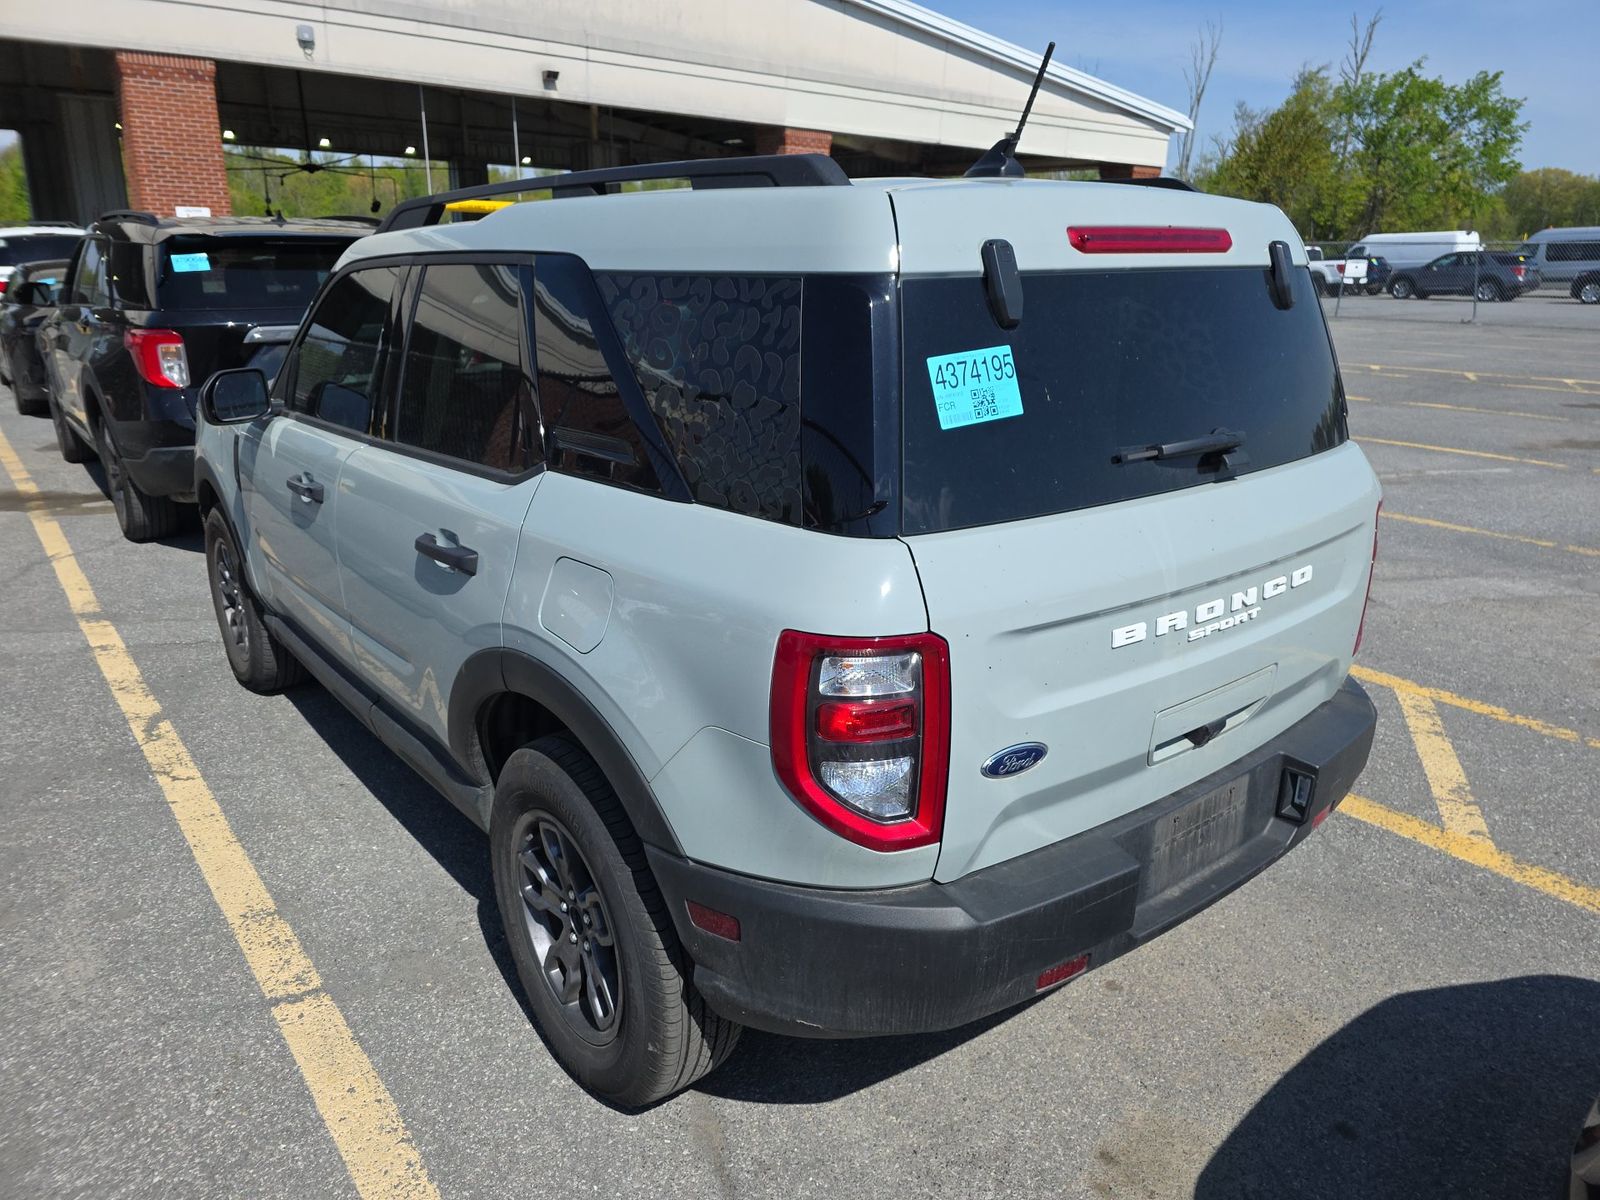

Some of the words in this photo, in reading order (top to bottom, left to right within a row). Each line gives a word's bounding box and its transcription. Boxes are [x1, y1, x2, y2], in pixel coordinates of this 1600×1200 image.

[935, 353, 1015, 390] 4374195
[938, 401, 956, 412] FCR
[1111, 564, 1313, 649] BRONCO
[1187, 606, 1262, 642] SPORT
[998, 750, 1036, 775] Ford
